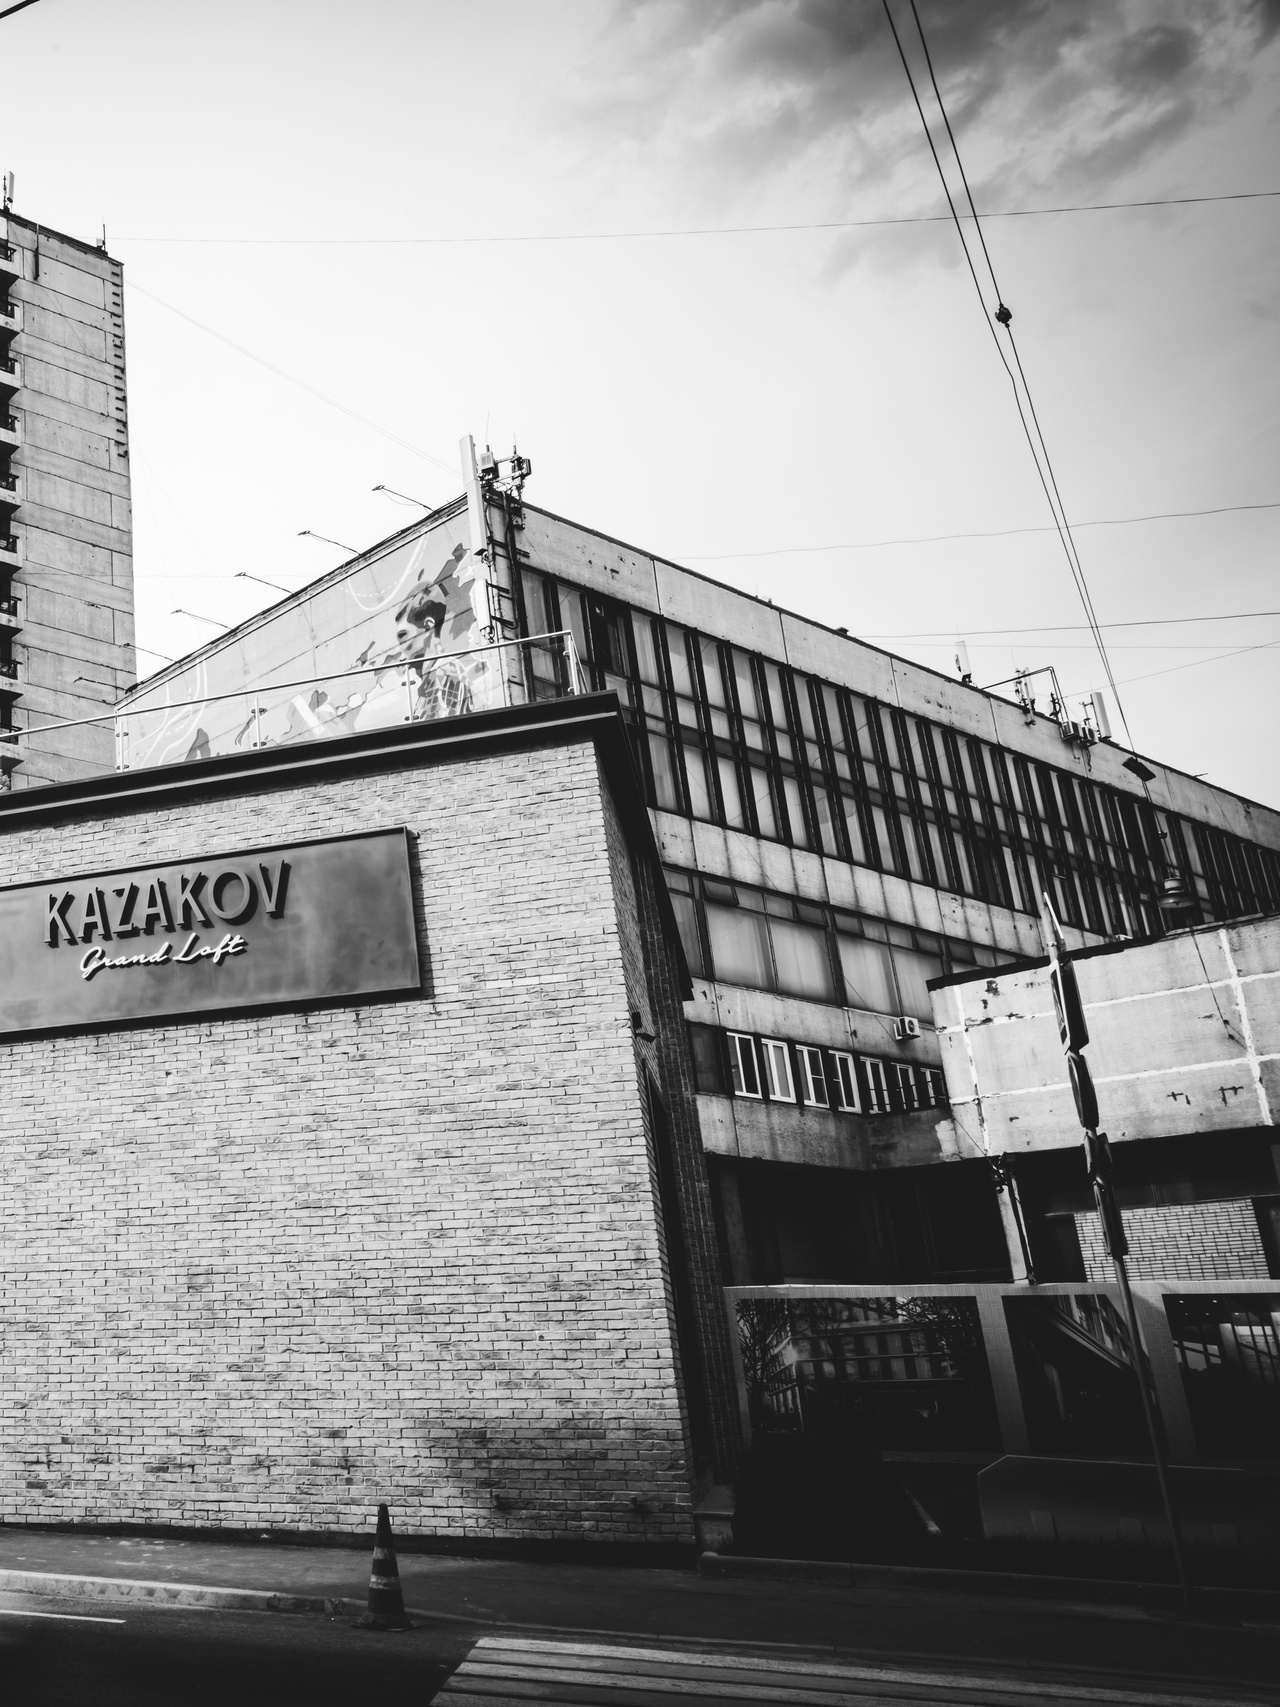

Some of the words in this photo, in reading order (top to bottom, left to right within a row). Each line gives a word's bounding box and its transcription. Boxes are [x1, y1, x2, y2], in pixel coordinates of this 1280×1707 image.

[44, 859, 288, 944] KAZAKOV
[79, 942, 170, 979] Grand
[172, 932, 245, 964] Loft
